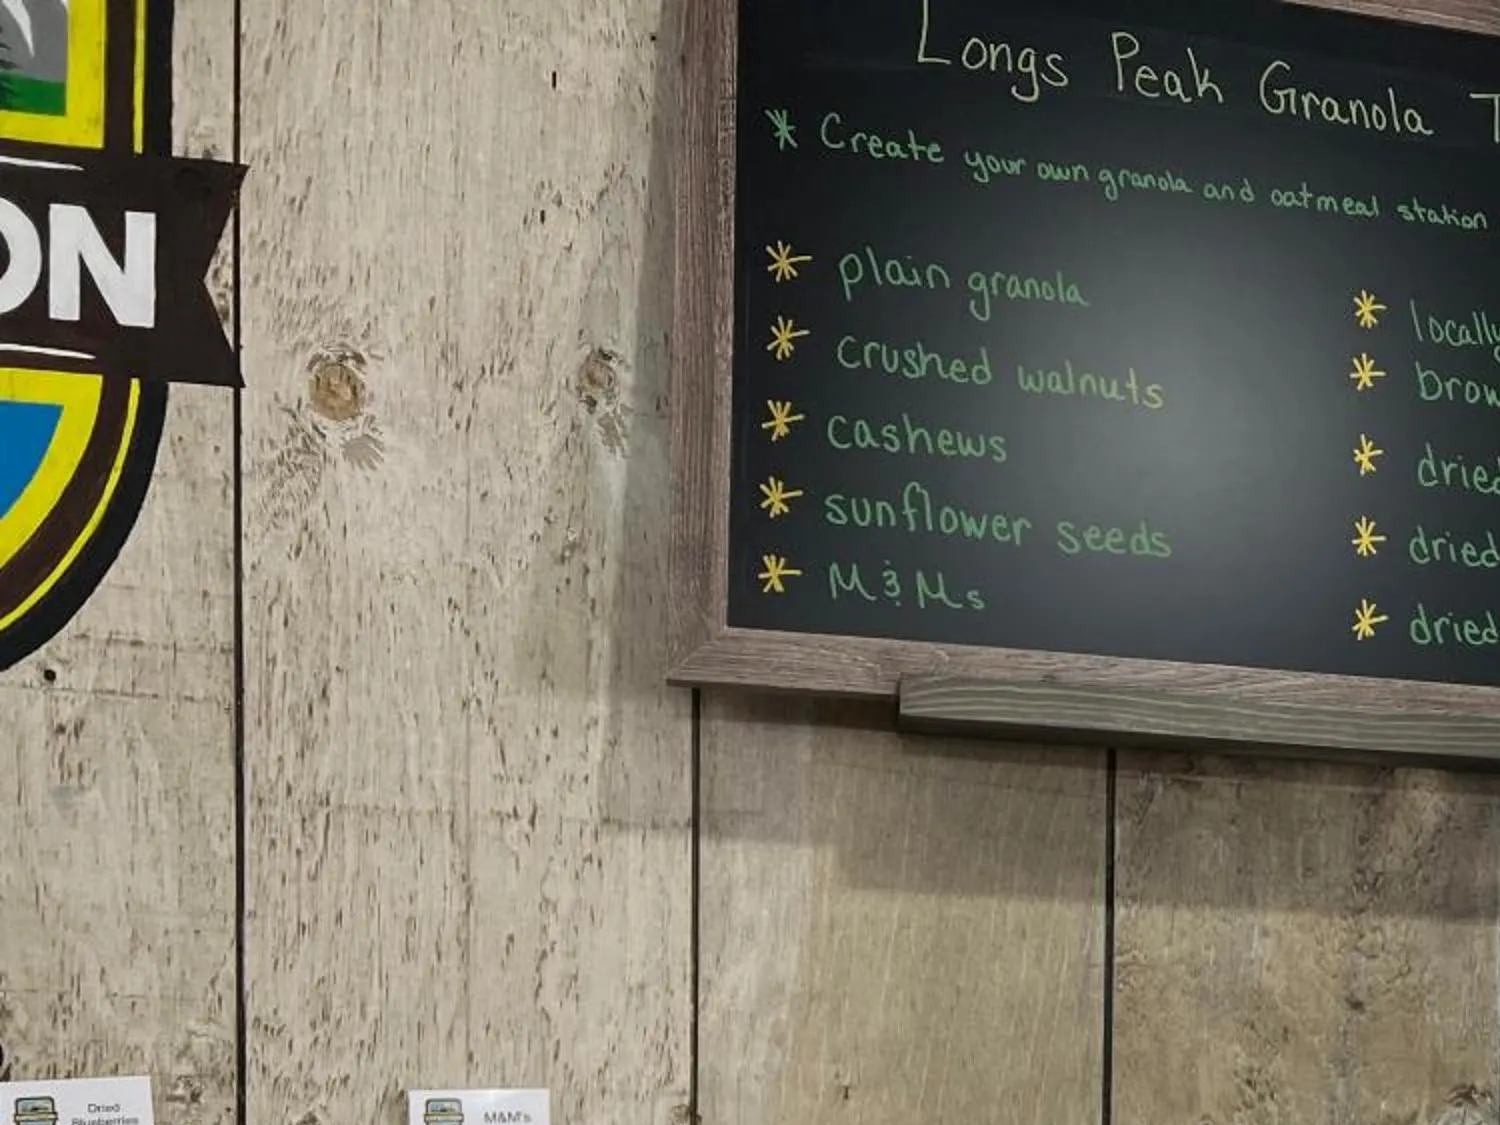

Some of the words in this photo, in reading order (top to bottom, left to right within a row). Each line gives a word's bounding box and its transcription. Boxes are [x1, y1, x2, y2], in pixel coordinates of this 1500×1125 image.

[917, 0, 1069, 102] Longs
[1111, 31, 1224, 103] Peak
[1259, 60, 1434, 137] Granola
[819, 112, 946, 165] Create
[964, 150, 1027, 184] your
[1037, 160, 1090, 184] own
[1098, 167, 1193, 200] granola
[1203, 178, 1255, 203] and
[1270, 182, 1381, 218] oatmeal
[1397, 199, 1489, 232] station
[837, 246, 952, 300] plain
[967, 268, 1091, 322] granola
[836, 334, 993, 386] crushed
[1017, 361, 1166, 410] walnuts
[826, 413, 1008, 464] cashews
[823, 481, 1034, 547] sunflower
[1056, 522, 1173, 559] seeds
[1408, 602, 1500, 647] dried
